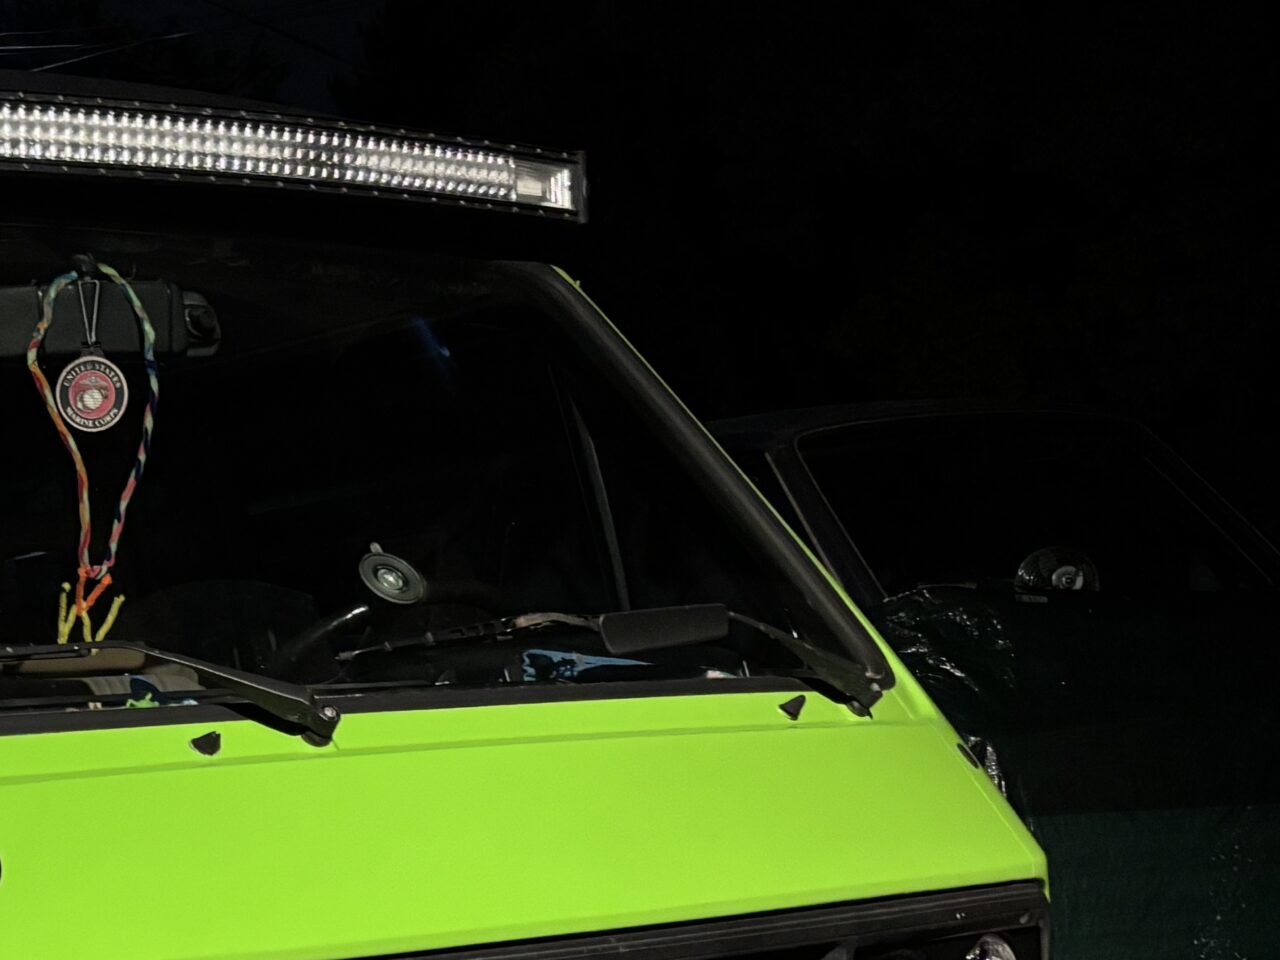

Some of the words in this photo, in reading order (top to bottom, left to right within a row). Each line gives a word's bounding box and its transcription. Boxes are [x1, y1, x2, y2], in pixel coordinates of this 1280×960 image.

[63, 363, 94, 387] UNITED
[94, 363, 122, 388] STATES
[66, 406, 95, 427] MARINE
